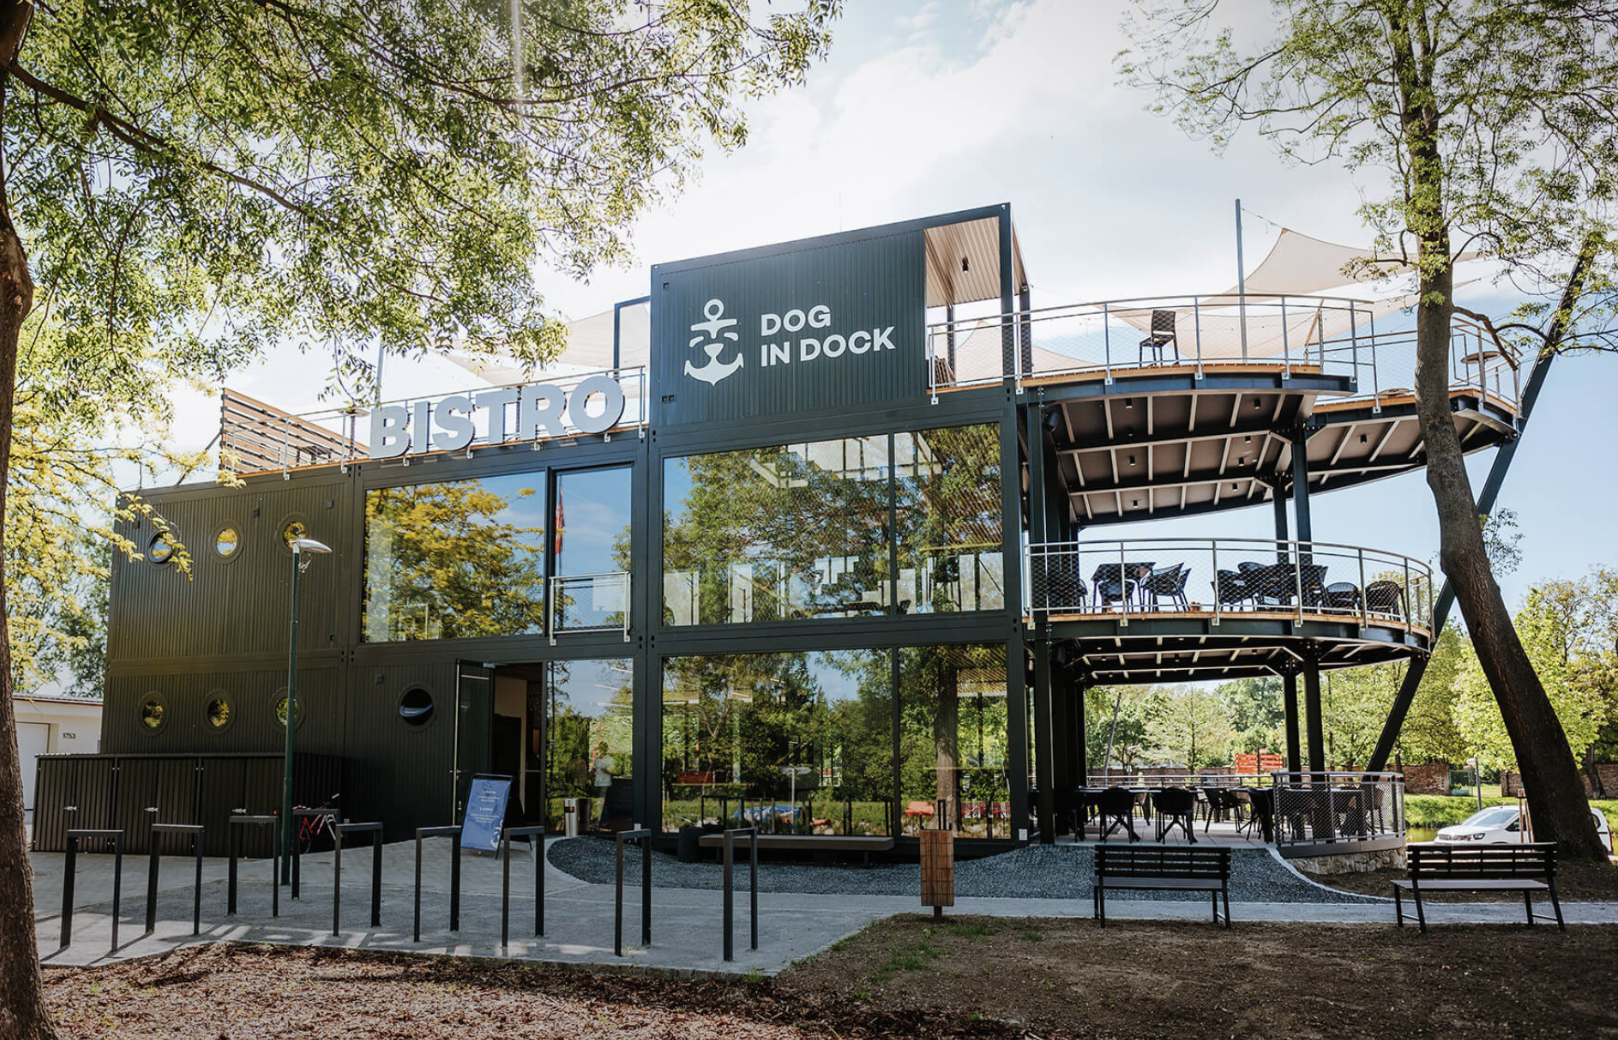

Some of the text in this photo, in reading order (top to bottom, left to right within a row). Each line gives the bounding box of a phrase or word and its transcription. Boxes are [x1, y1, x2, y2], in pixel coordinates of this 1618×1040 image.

[761, 304, 831, 337] DOG
[761, 326, 896, 367] IN DOCK
[369, 375, 625, 459] BISTRO
[62, 732, 76, 740] 1753
